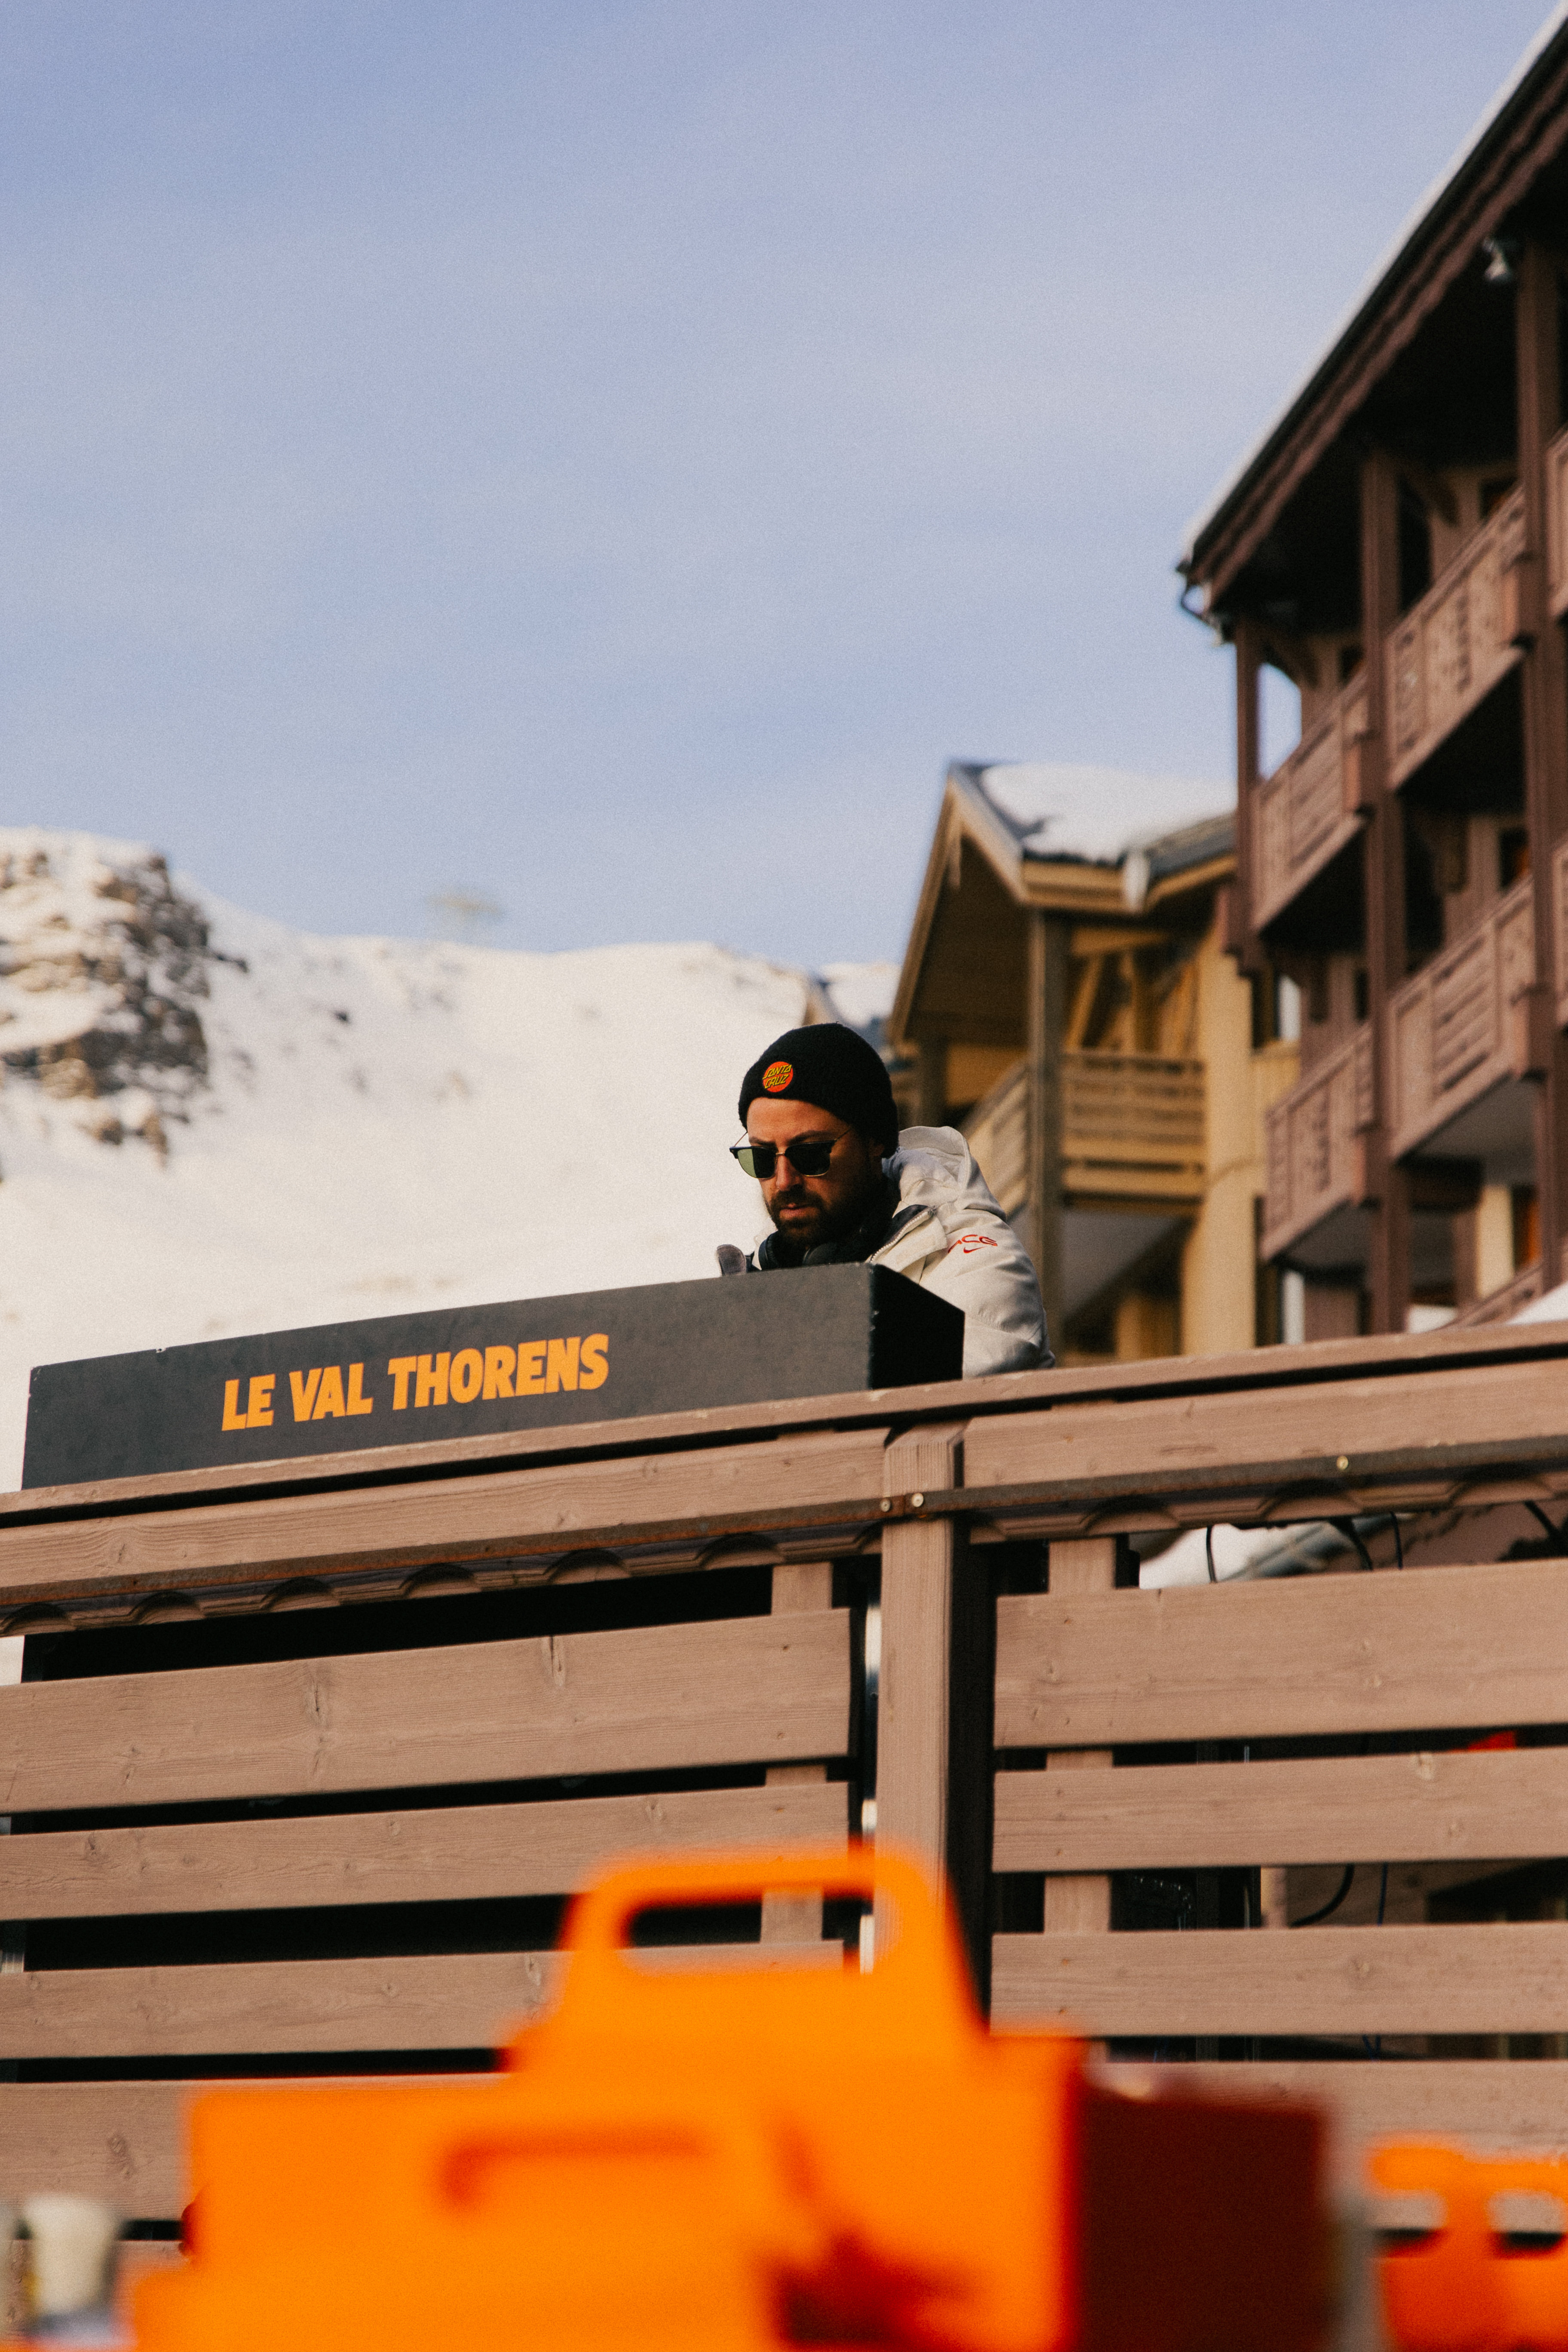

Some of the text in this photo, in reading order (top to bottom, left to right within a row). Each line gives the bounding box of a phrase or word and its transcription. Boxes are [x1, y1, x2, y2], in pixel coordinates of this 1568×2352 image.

[762, 1064, 792, 1079] SANTA
[765, 1074, 789, 1089] CRUZ
[221, 1333, 609, 1431] LE VAL THORENS
